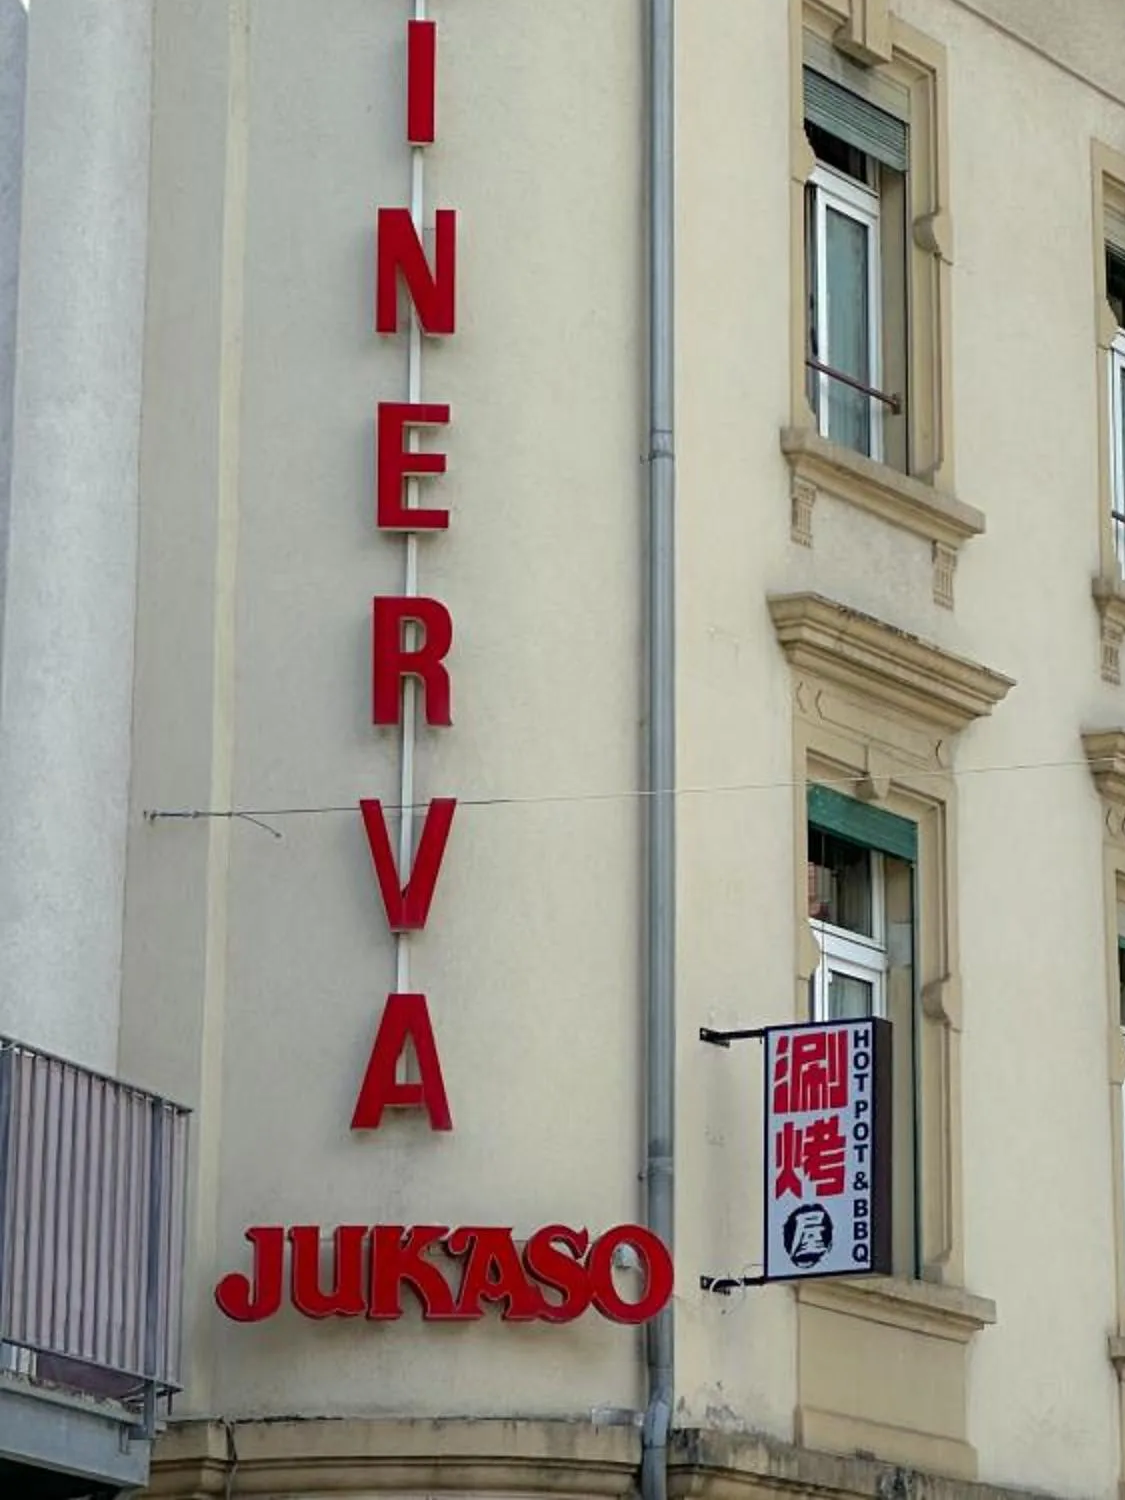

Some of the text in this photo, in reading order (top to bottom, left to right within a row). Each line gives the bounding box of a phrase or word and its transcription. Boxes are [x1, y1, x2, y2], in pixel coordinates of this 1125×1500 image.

[852, 1029, 870, 1263] HOT POT & BBQ
[215, 1224, 674, 1325] JUKASO
